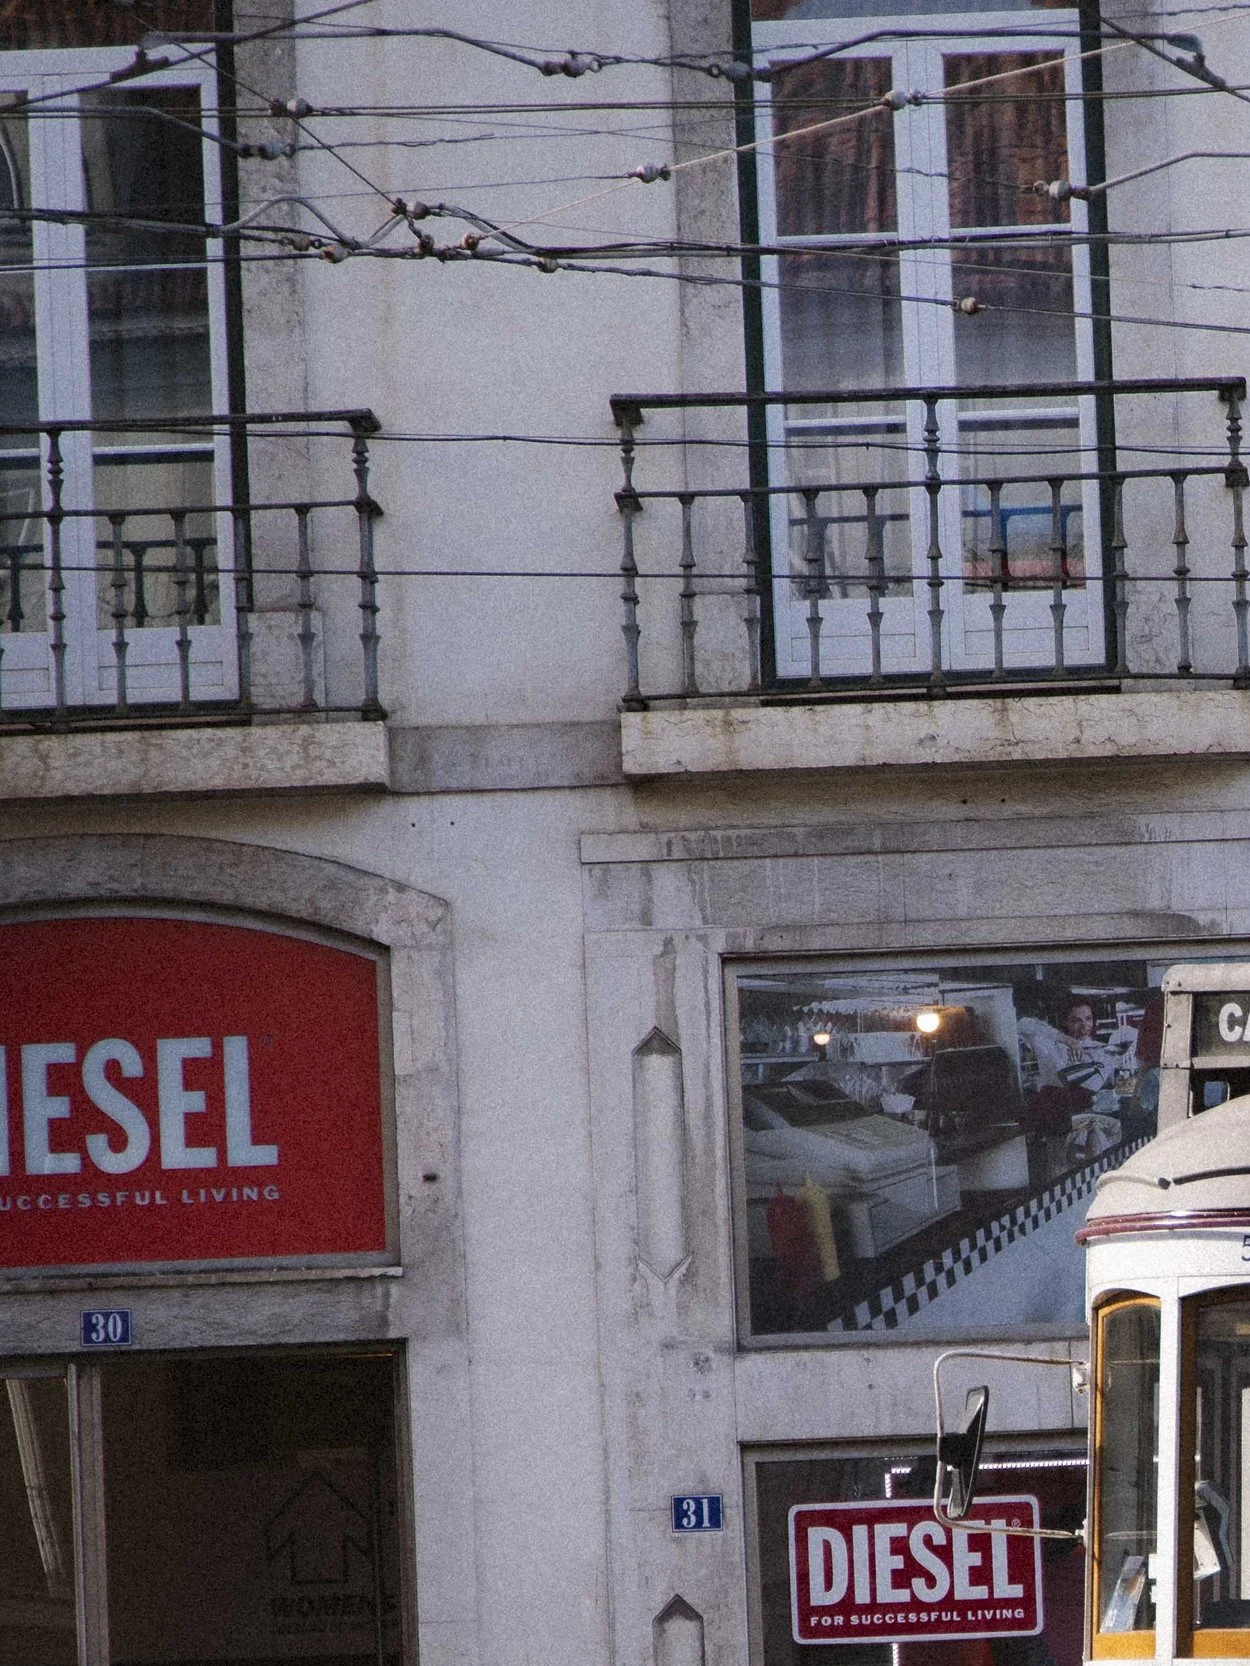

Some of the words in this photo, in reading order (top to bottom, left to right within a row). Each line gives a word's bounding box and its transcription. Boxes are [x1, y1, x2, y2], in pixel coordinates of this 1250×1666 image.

[0, 1036, 280, 1177] ESEL
[0, 1189, 168, 1212] UCCESSFUL
[181, 1184, 281, 1204] LIVING
[90, 1312, 122, 1344] 30
[682, 1497, 711, 1530] 31
[807, 1519, 1025, 1607] DIESEL
[810, 1613, 845, 1628] FOR
[849, 1610, 962, 1627] SUCCESSFUL
[967, 1608, 1026, 1623] LIVING
